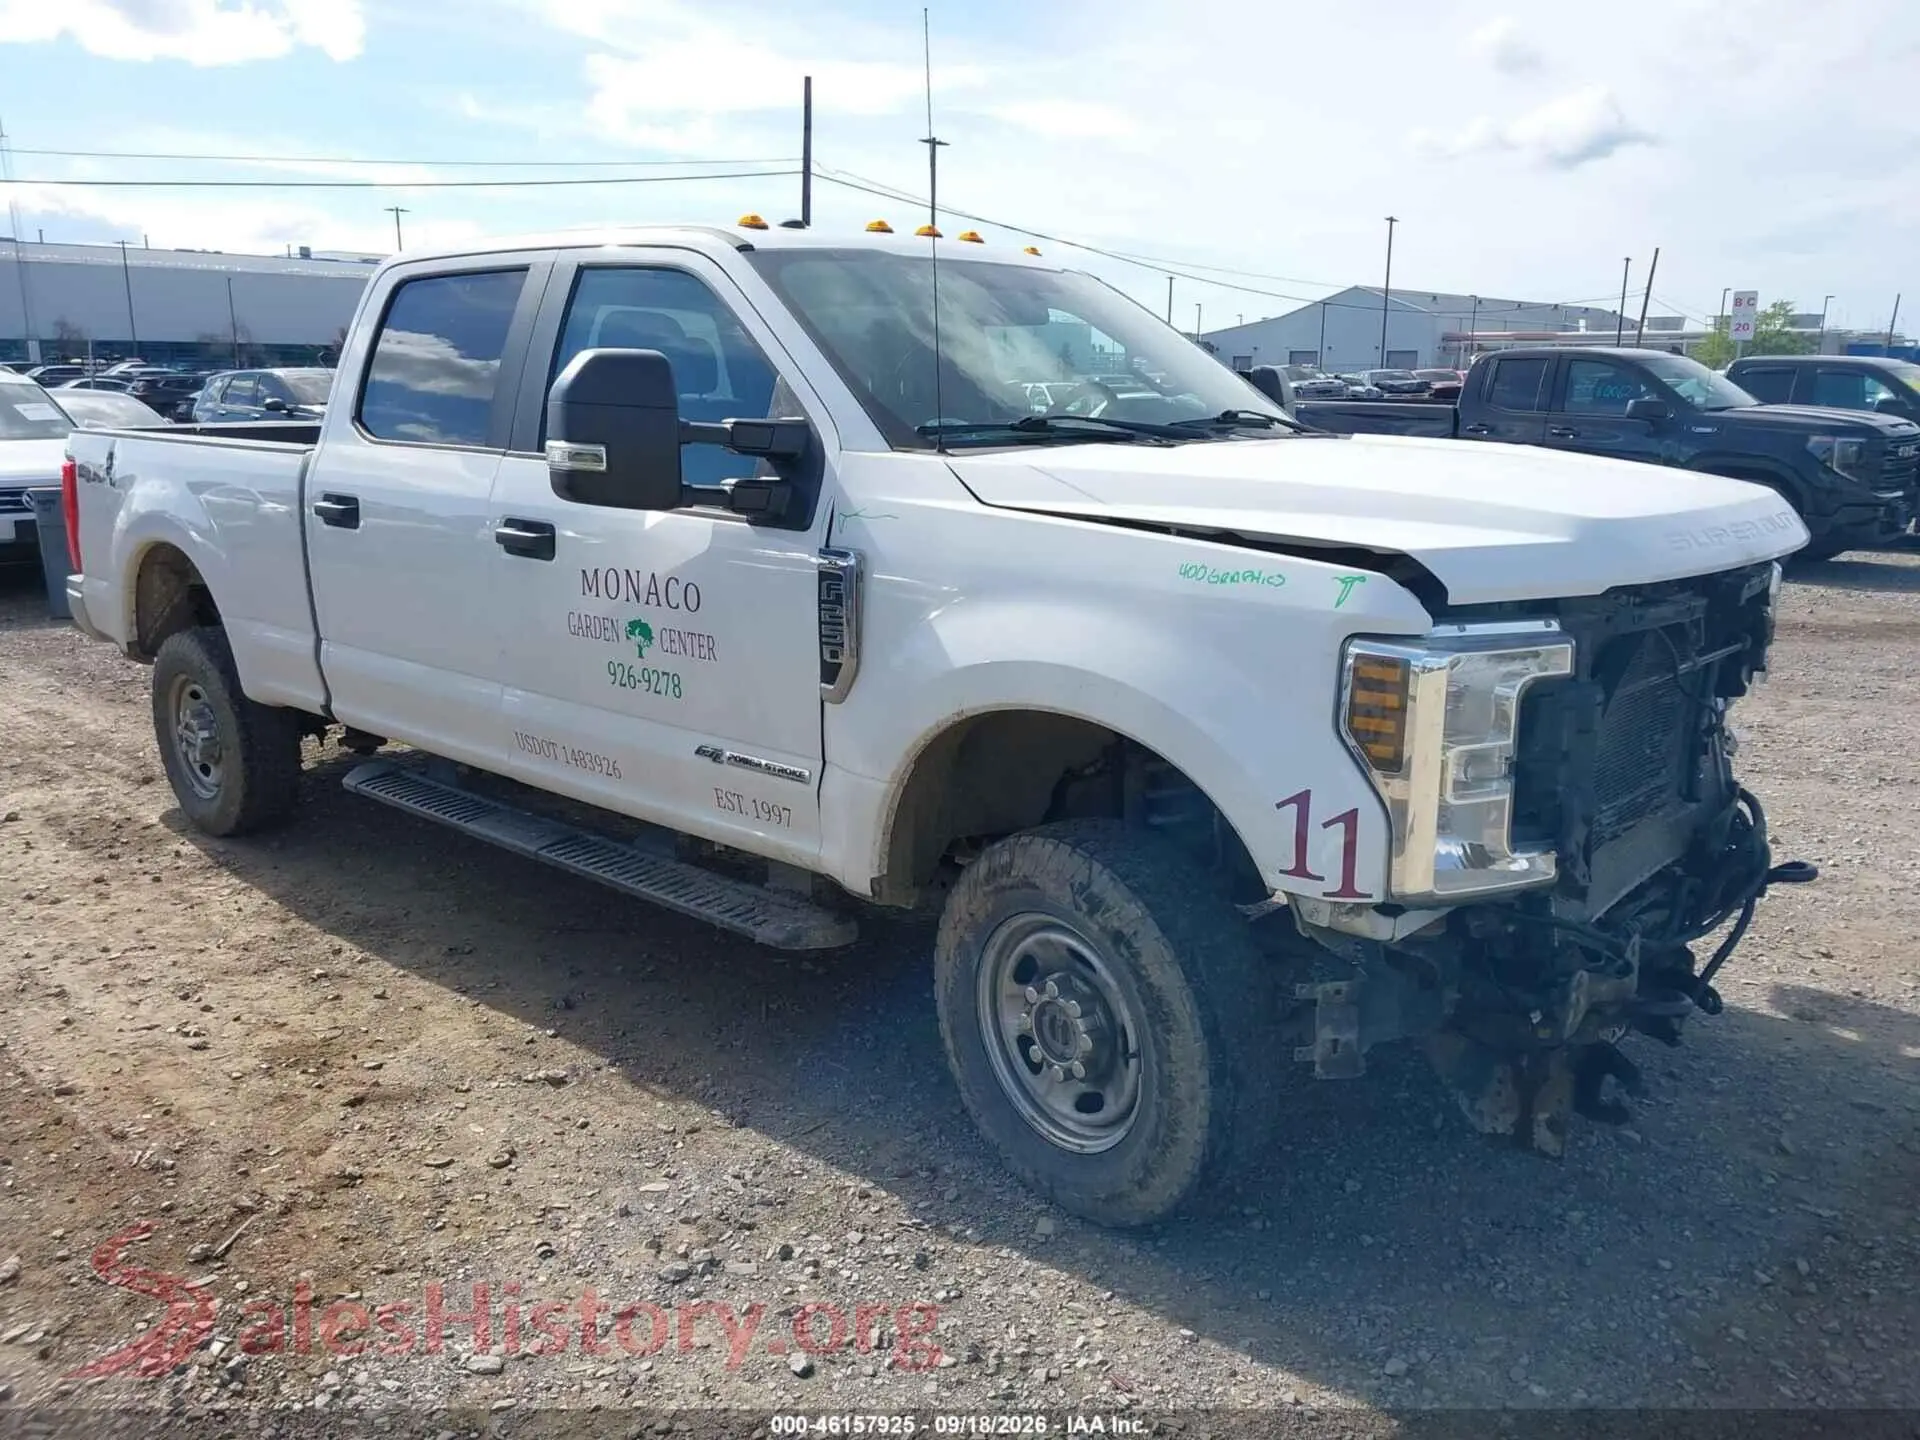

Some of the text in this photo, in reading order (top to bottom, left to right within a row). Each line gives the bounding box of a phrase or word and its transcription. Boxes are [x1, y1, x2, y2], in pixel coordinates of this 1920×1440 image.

[1735, 322, 1750, 331] 20
[1664, 519, 1761, 551] SUPER
[581, 567, 701, 613] MONACO
[568, 611, 718, 662] GARDEN CENTER
[607, 660, 682, 699] 926-9278
[514, 731, 623, 780] USDOT 1483926
[713, 787, 792, 828] EST. 1997
[1275, 788, 1374, 899] 11
